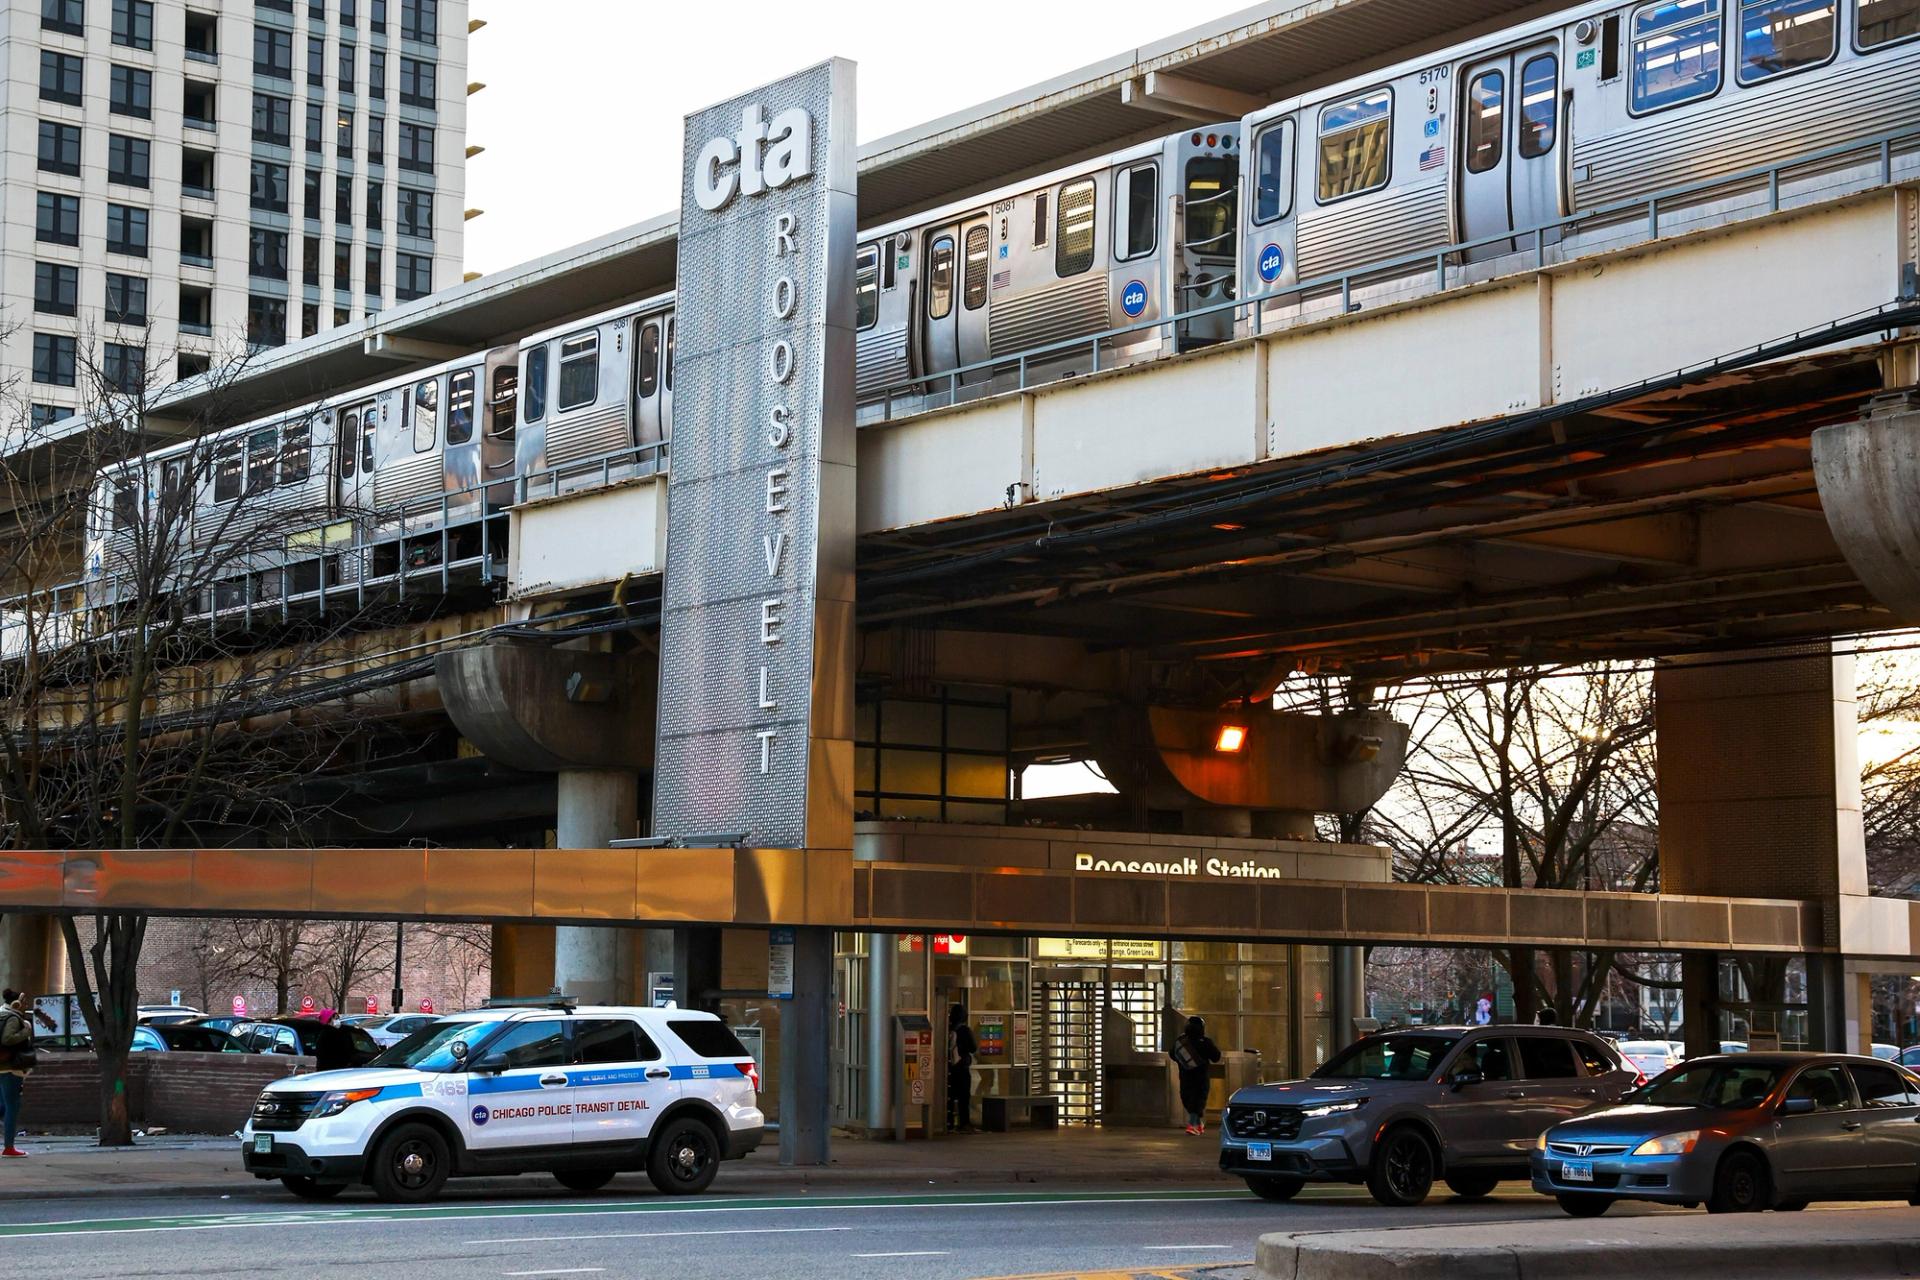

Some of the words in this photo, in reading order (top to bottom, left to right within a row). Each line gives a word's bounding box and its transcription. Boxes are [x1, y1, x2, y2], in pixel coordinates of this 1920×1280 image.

[1420, 65, 1449, 84] 5170
[694, 103, 812, 211] cta
[996, 199, 1015, 214] 5081
[1262, 255, 1280, 271] cta
[1125, 292, 1143, 305] cta
[757, 212, 797, 774] ROOSEVELT
[423, 1080, 466, 1097] 2465
[492, 1106, 535, 1120] CHICAGO
[538, 1104, 572, 1117] POLICE
[576, 1101, 614, 1114] TRANSIT
[618, 1100, 650, 1111] DETAIL
